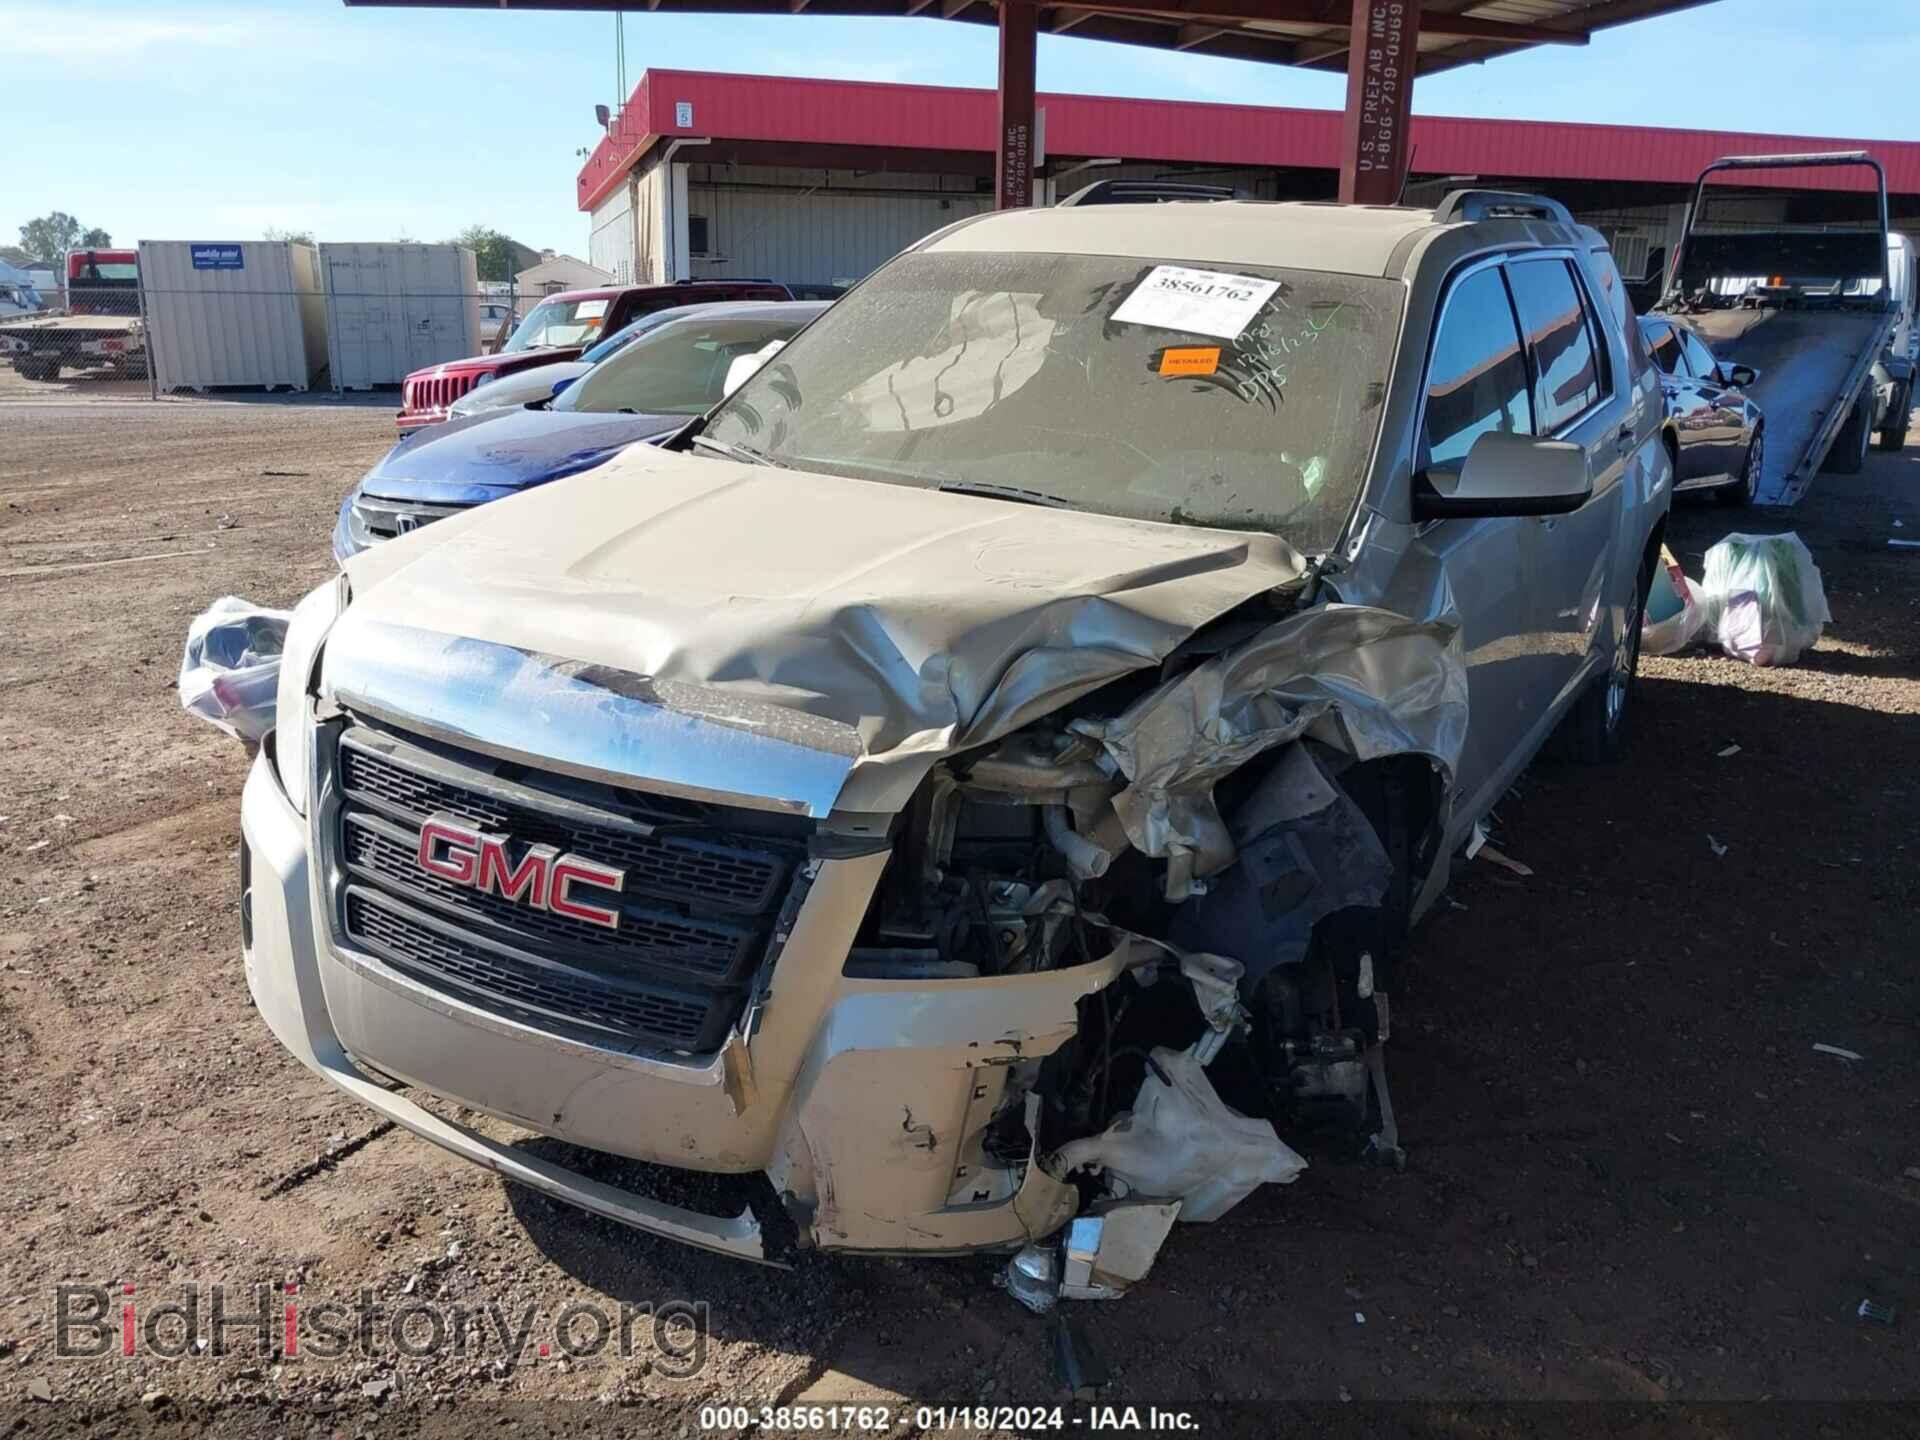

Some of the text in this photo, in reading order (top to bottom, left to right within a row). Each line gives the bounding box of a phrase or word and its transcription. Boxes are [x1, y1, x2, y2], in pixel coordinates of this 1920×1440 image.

[1359, 1, 1387, 171] U.S. PREFAB INC.
[1375, 3, 1403, 170] 1-866-799-0969
[1153, 278, 1254, 301] 38561762
[417, 810, 626, 929] GMC
